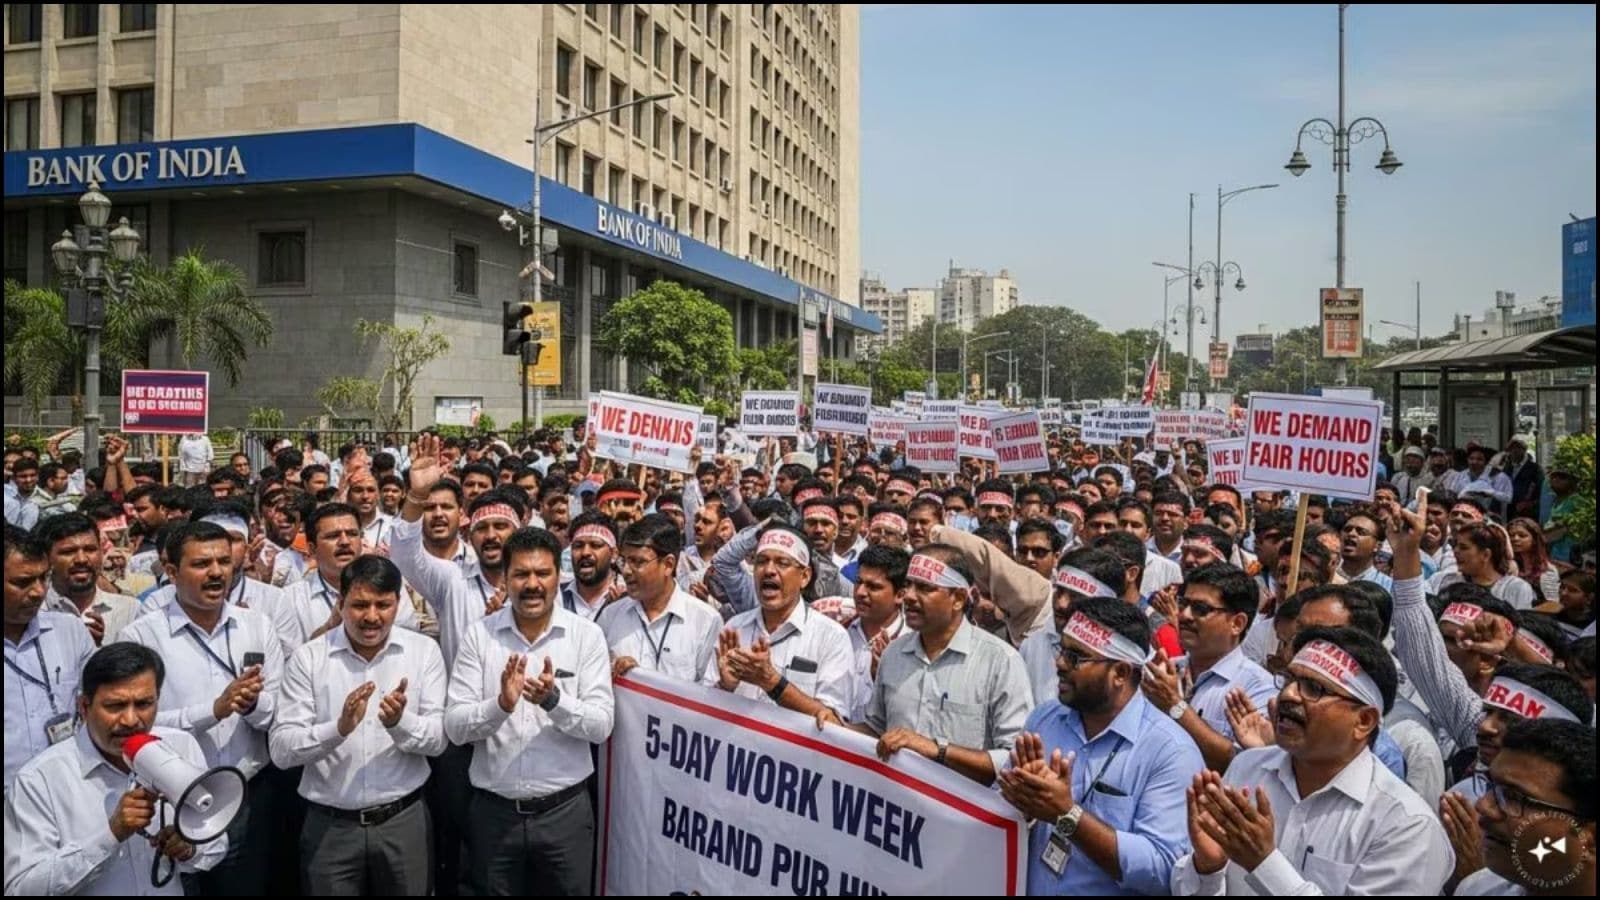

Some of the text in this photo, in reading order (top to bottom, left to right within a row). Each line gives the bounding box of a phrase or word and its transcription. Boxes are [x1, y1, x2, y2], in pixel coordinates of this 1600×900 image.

[27, 145, 246, 187] BANK OF INDIA
[598, 205, 682, 259] BANK OF INDIA
[601, 405, 626, 433] WE
[1254, 410, 1282, 436] WE
[1287, 413, 1372, 444] DEMAND
[1250, 441, 1369, 478] FAIR HOURS
[646, 714, 926, 869] 5-DAY WORK WEEK
[662, 797, 830, 896] BARAND PUR
